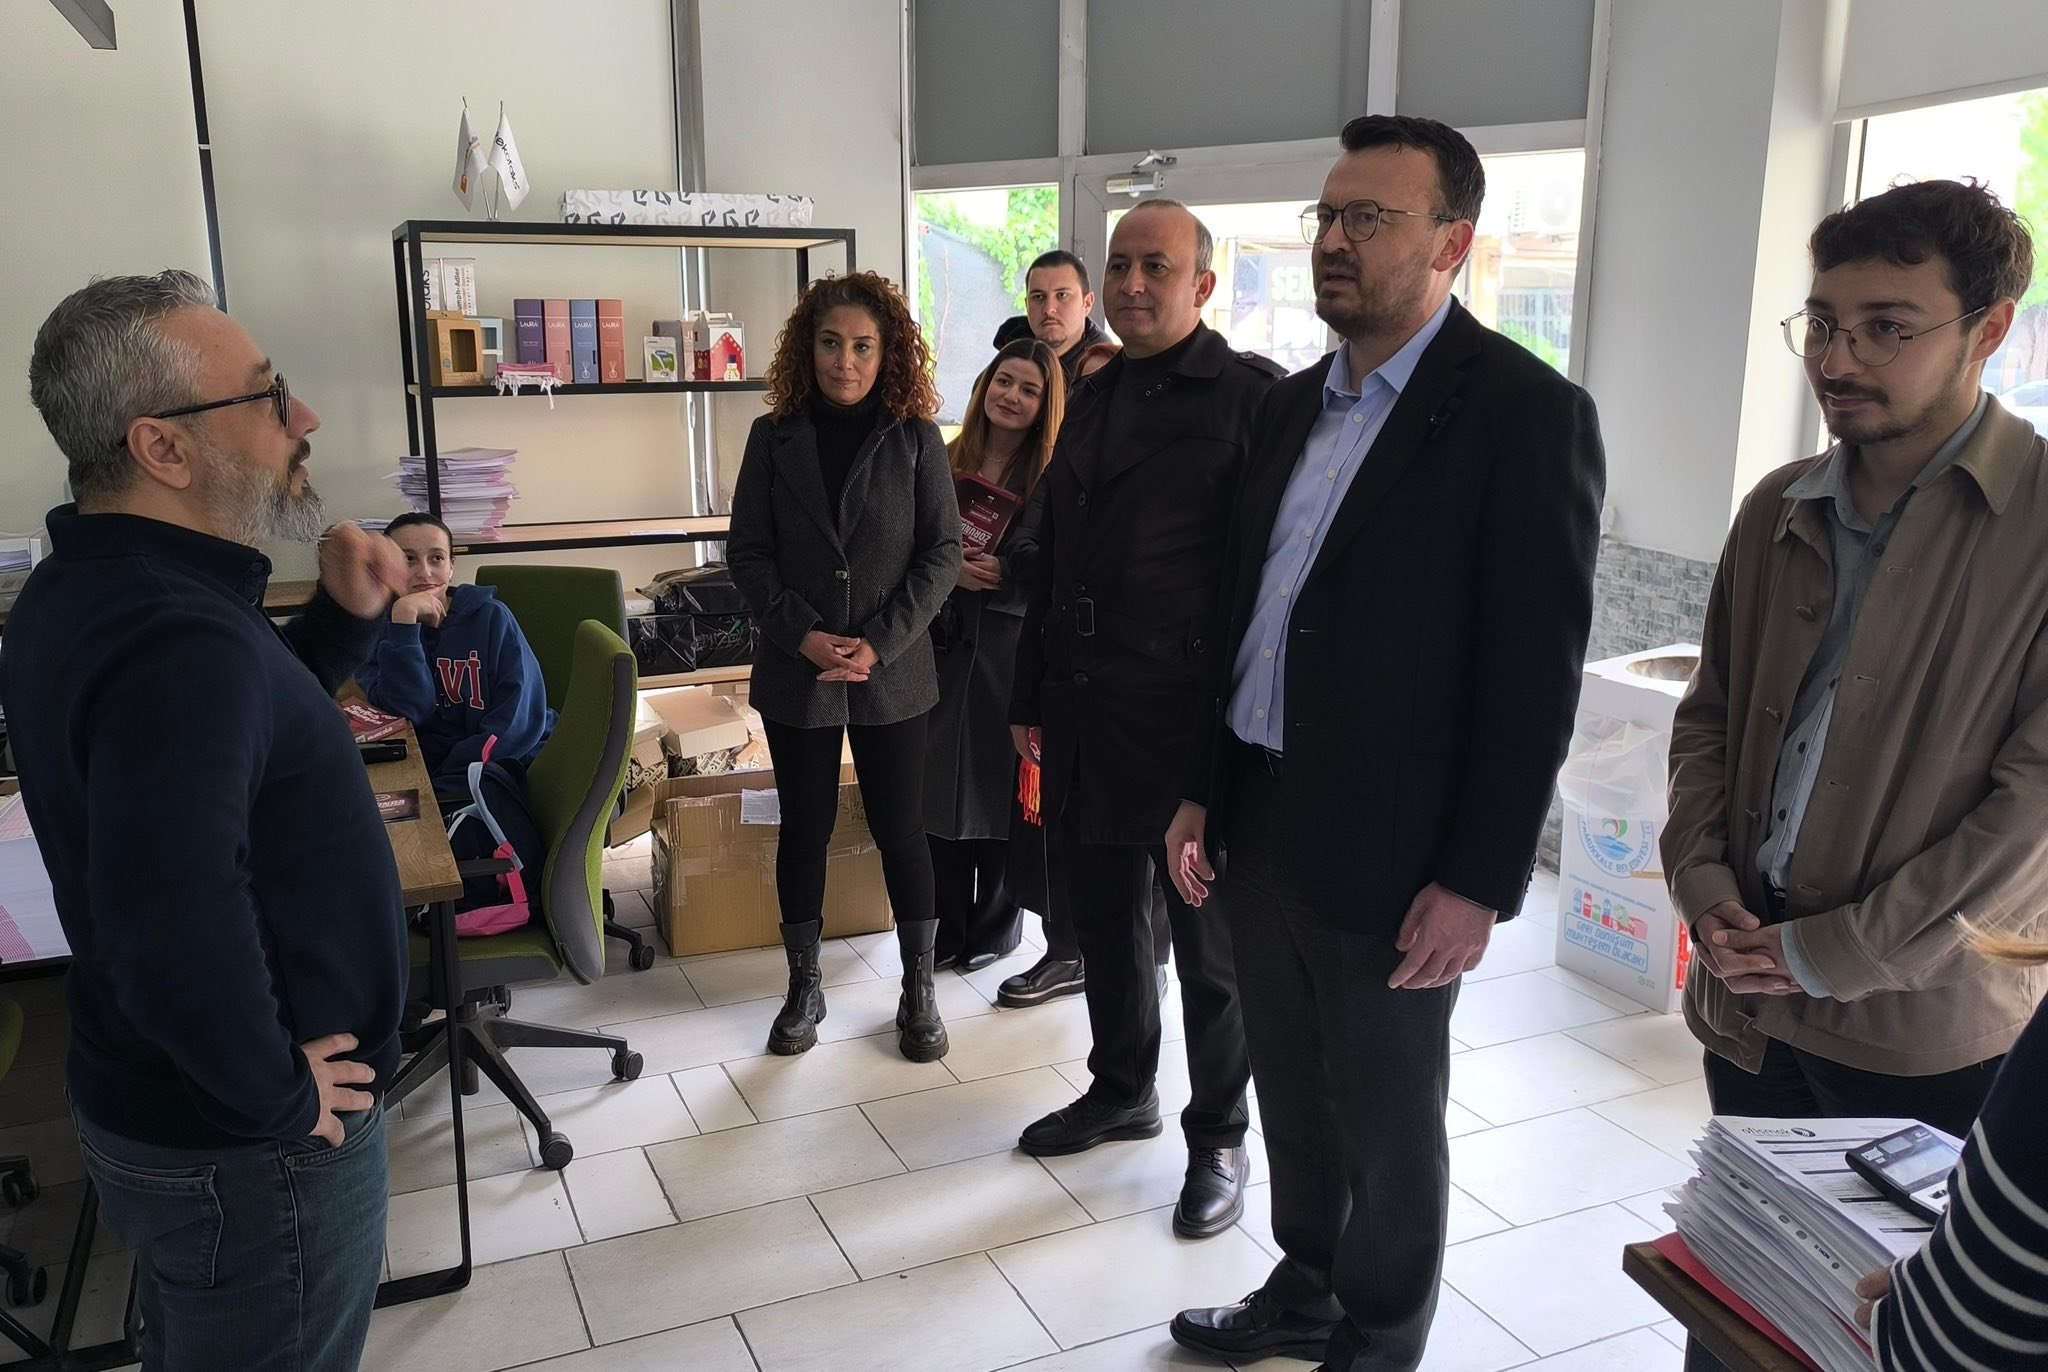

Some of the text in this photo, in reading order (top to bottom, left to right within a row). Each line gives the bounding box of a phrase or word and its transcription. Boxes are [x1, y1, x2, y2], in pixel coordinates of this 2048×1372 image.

[547, 321, 566, 329] LAURA
[574, 321, 593, 329] LAURA
[601, 321, 620, 329] LAURA
